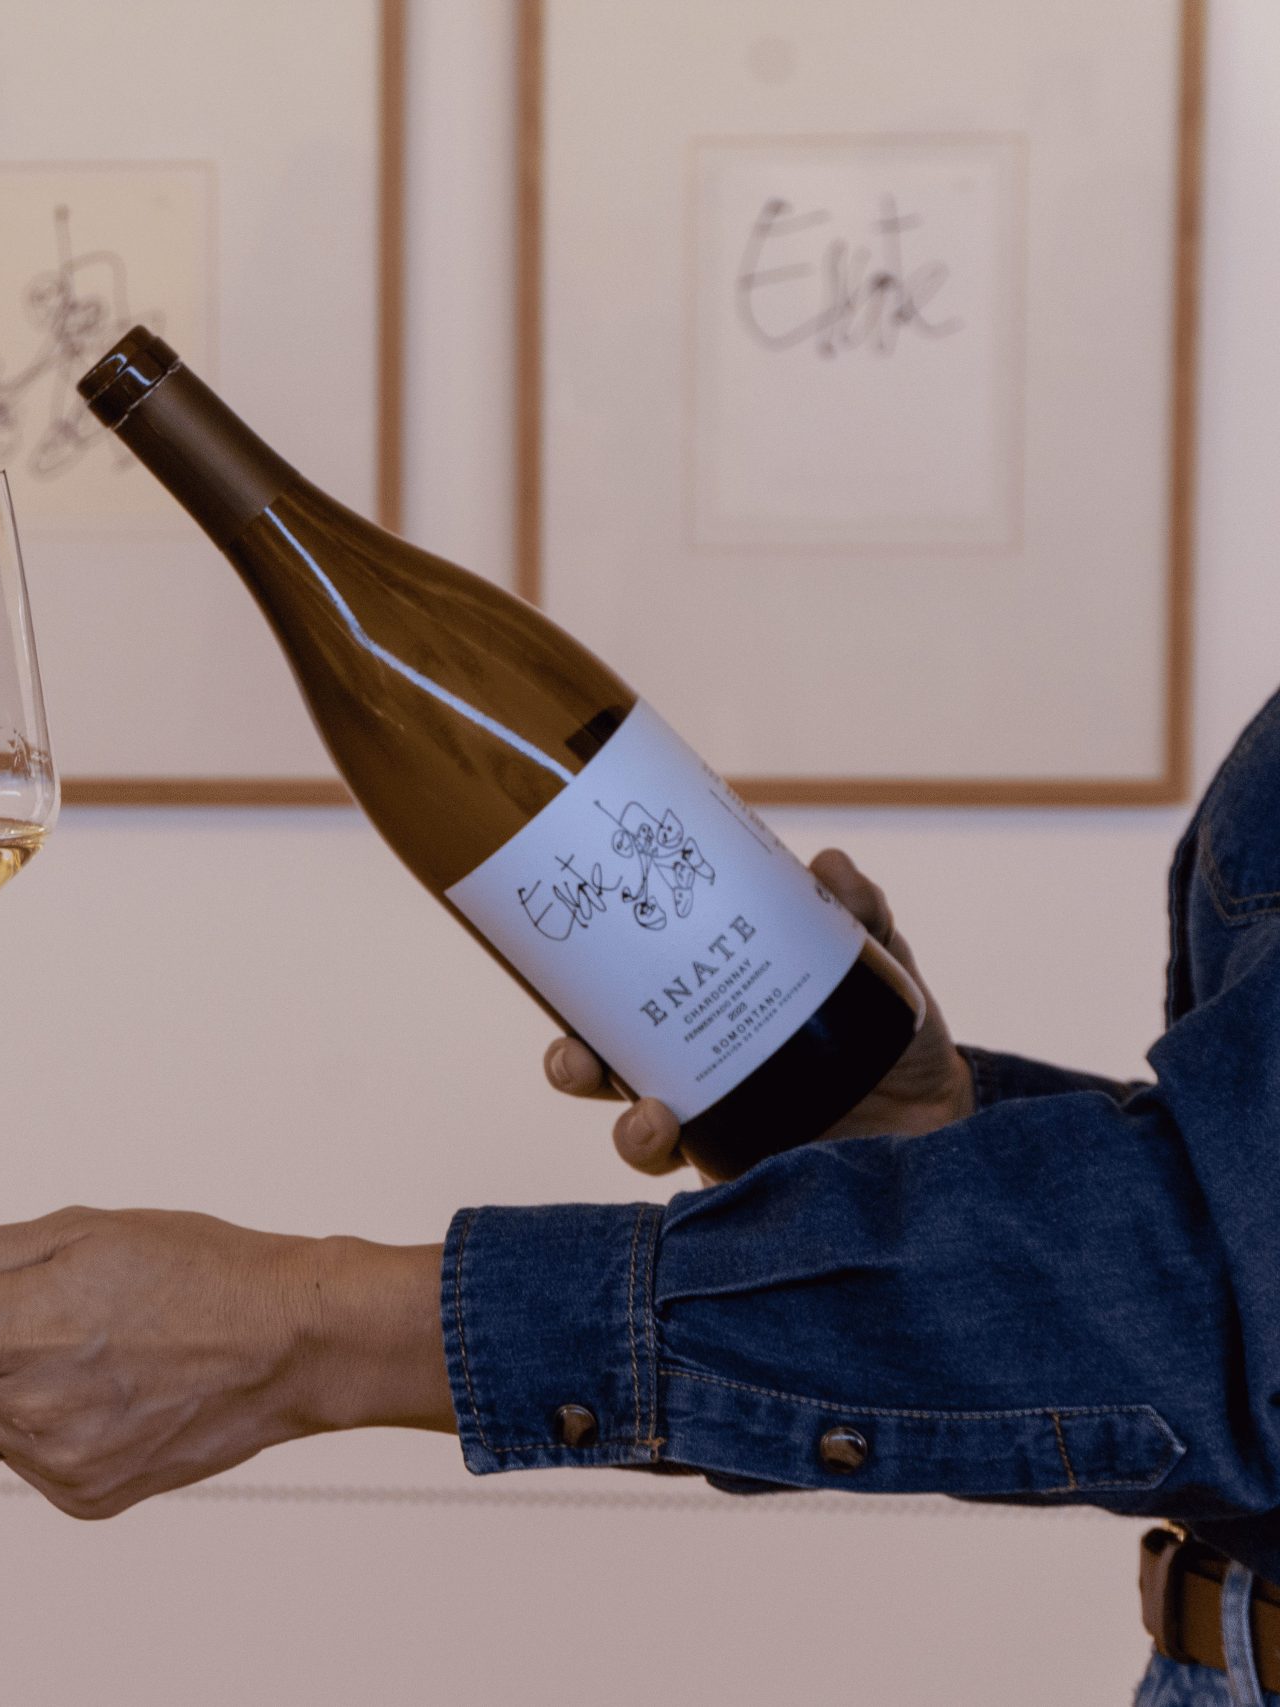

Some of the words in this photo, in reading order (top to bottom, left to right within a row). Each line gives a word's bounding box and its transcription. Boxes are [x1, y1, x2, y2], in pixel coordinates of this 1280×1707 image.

[640, 915, 756, 1027] ENATE
[683, 958, 752, 1025] CHARDONNAY
[684, 1001, 733, 1043] FERMENTADO
[730, 989, 744, 1004] EN
[743, 960, 773, 993] BARRICA
[712, 987, 783, 1055] SOMONTANO
